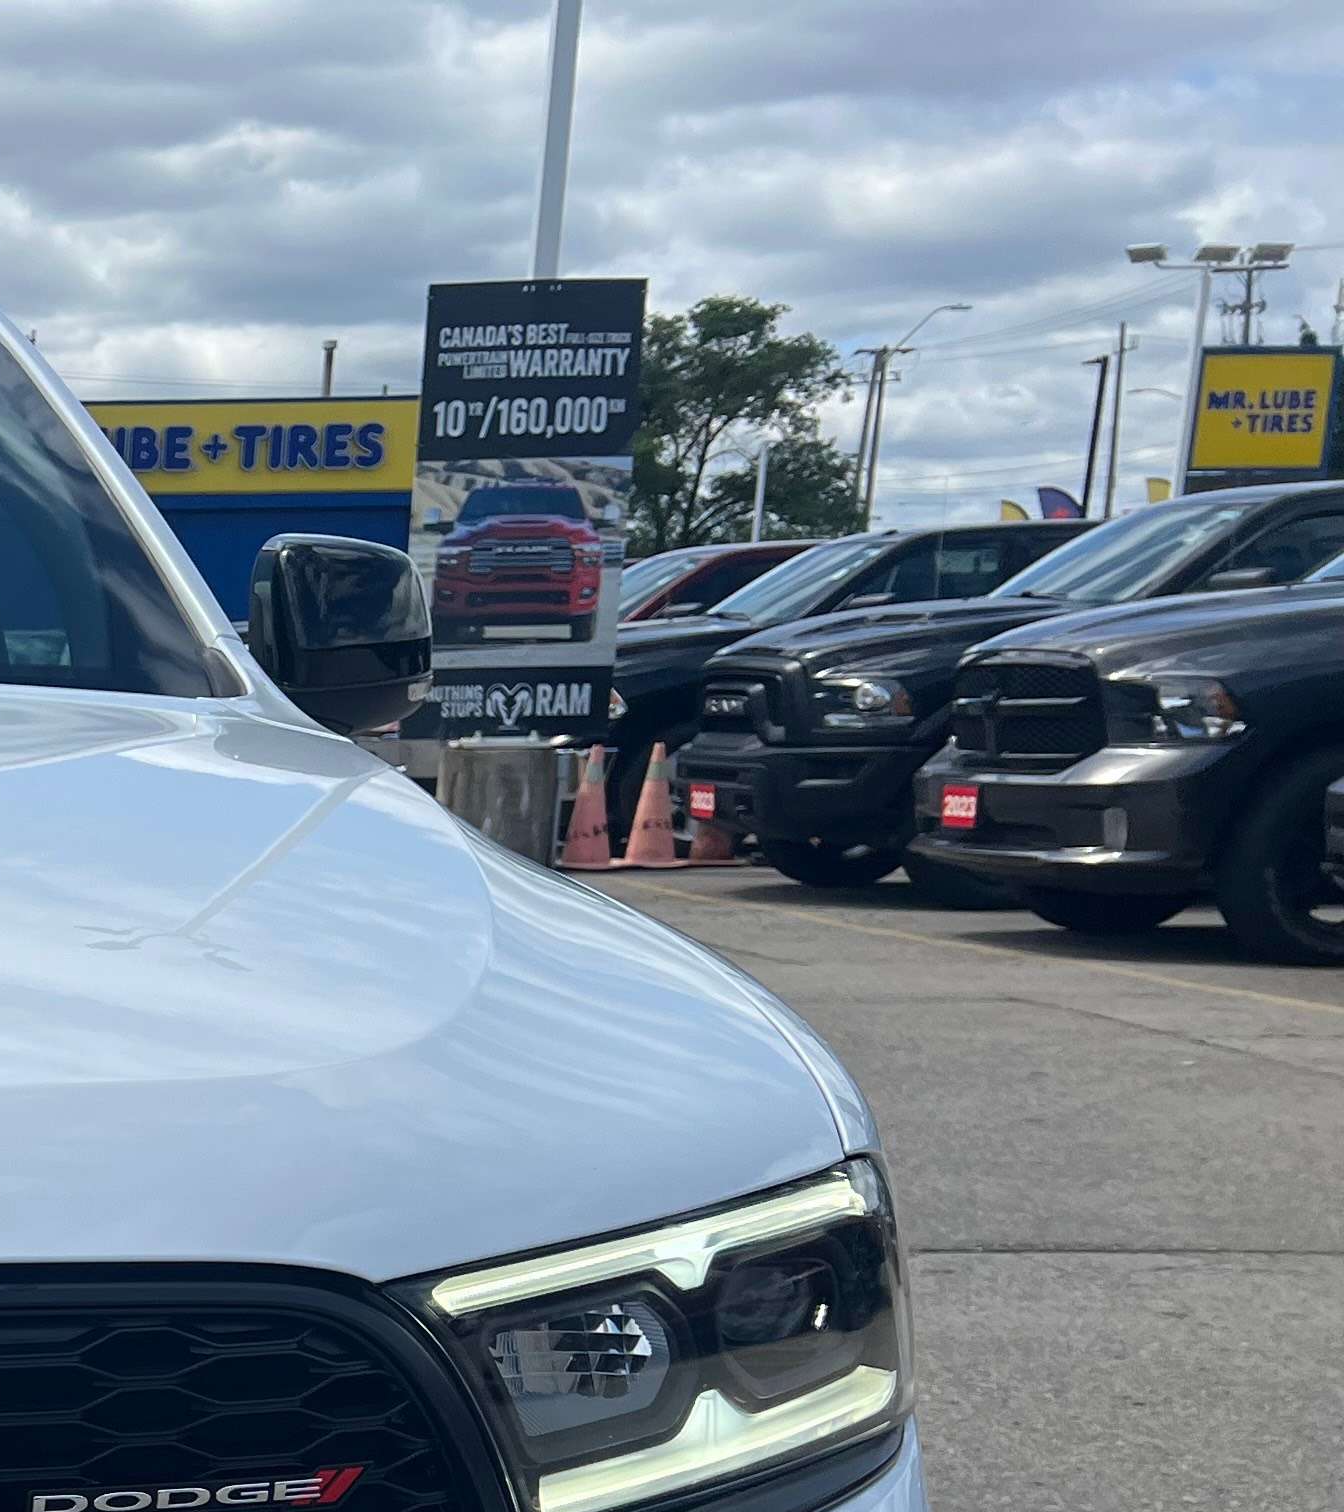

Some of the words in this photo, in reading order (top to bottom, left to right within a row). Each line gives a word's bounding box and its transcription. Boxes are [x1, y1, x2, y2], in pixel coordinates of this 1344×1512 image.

[439, 324, 523, 348] CANADA'S
[526, 323, 569, 345] BEST
[510, 348, 630, 377] WARRANTY
[1208, 390, 1254, 409] MR.
[1260, 389, 1316, 409] LUBE
[1247, 413, 1313, 433] TIRES
[233, 423, 385, 471] TIRES
[440, 701, 483, 718] STOPS
[536, 683, 592, 716] RAM
[943, 795, 976, 817] 2023
